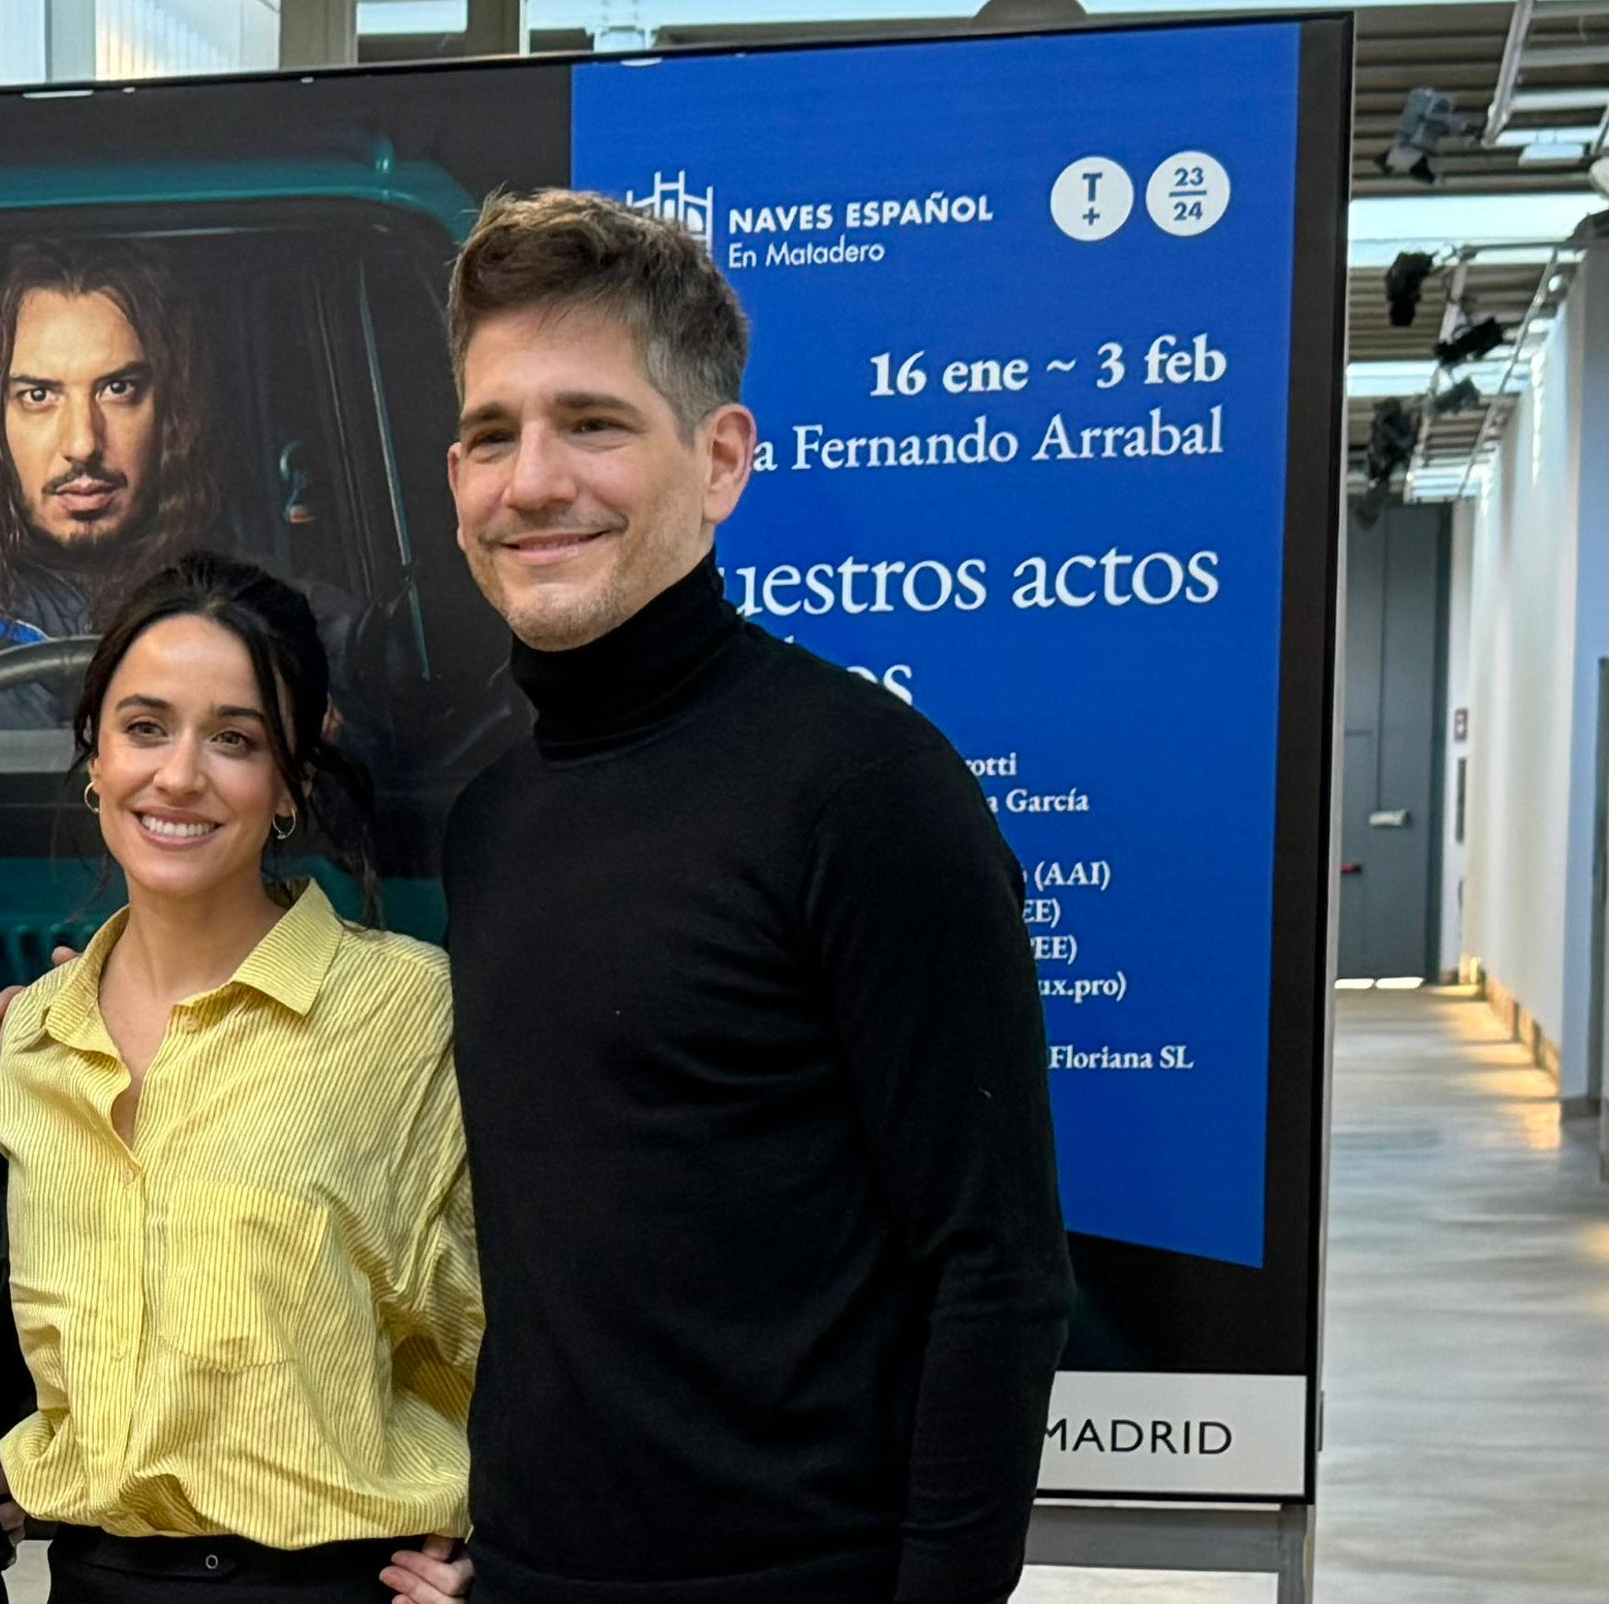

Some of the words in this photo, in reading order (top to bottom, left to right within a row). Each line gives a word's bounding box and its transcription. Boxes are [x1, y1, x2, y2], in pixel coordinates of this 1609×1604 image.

[1174, 166, 1204, 187] 23
[729, 204, 833, 235] NAVES
[846, 190, 993, 228] ESPAÑOL
[1173, 201, 1204, 222] 24
[729, 242, 757, 268] En
[765, 234, 885, 267] Matadero
[870, 350, 927, 397] 16
[942, 357, 1029, 394] ene
[1096, 342, 1126, 388] 3
[1143, 333, 1227, 385] feb
[791, 415, 1018, 471] Fernando
[1031, 404, 1224, 461] Arrabal
[717, 551, 988, 617] uestros
[1011, 547, 1220, 610] actos
[965, 752, 1017, 776] otti
[1006, 787, 1090, 813] García
[1034, 860, 1111, 891] (AAI)
[1022, 898, 1061, 929] EE)
[1030, 934, 1078, 965] EE)
[1038, 971, 1127, 1003] ux.pro)
[1048, 1044, 1154, 1070] Floriana
[1159, 1044, 1195, 1070] SL
